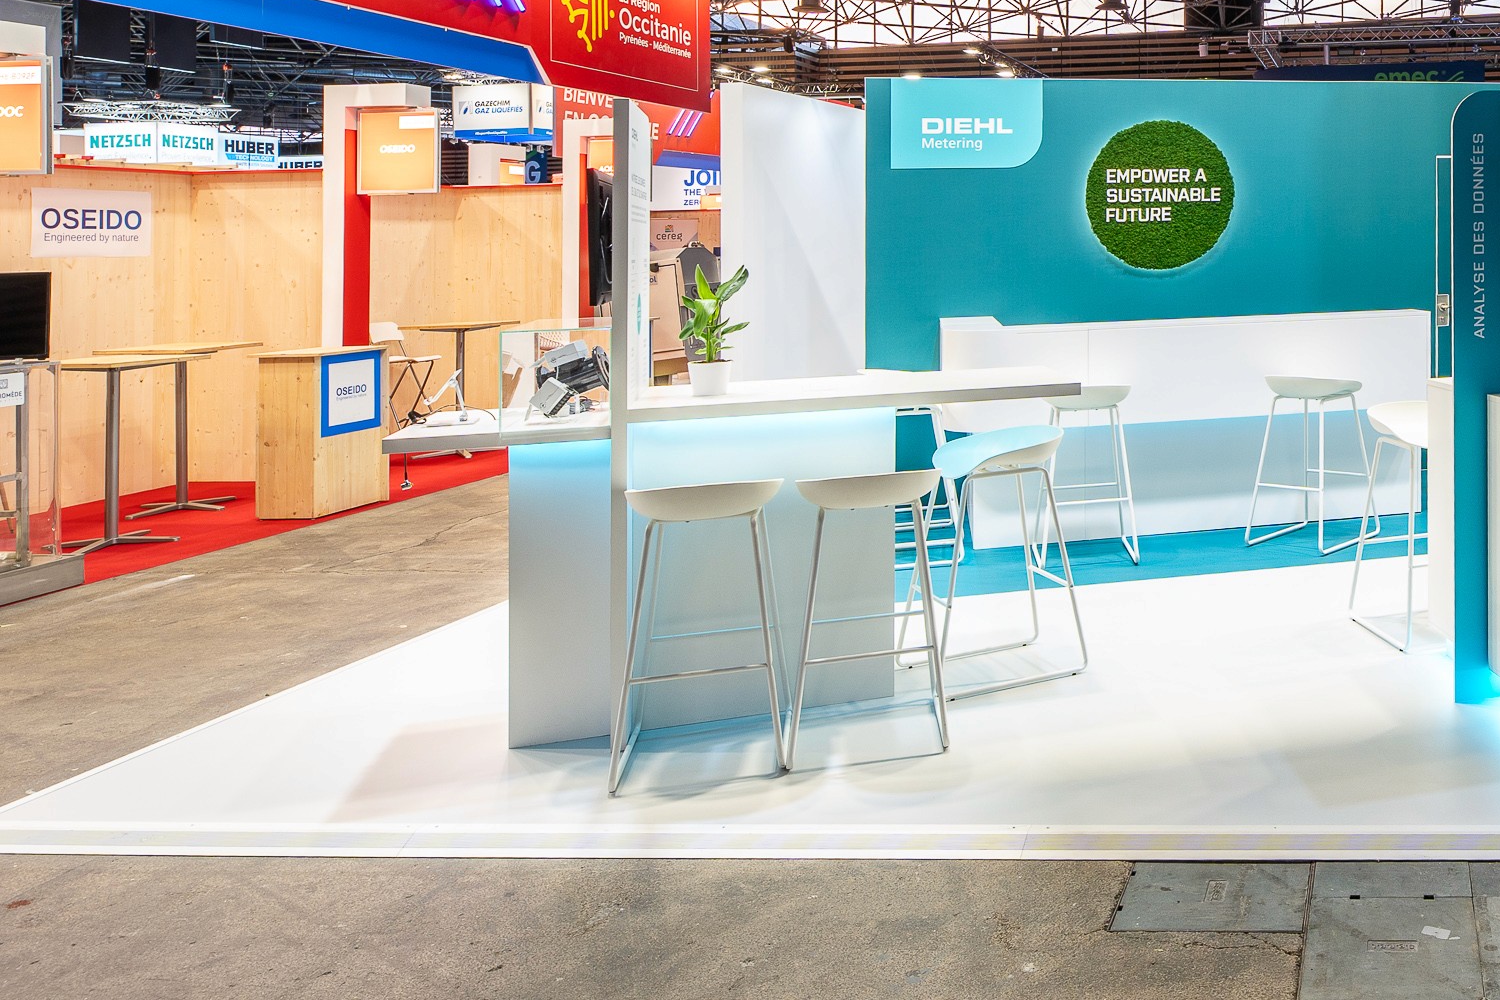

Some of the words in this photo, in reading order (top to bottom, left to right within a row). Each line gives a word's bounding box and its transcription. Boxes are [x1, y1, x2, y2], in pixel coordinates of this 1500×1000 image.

[619, 8, 692, 46] Occitanie
[620, 32, 649, 48] Pyrénées
[652, 40, 692, 58] Méditerranée
[564, 88, 613, 108] BIENVE
[922, 118, 1014, 134] DIEHL
[90, 134, 152, 148] NETZSCH
[162, 134, 214, 150] NETZSCH
[224, 140, 274, 154] HUBER
[922, 138, 983, 152] Metering
[235, 154, 274, 162] TECHNOLOGY
[684, 170, 721, 187] JOI
[1106, 168, 1190, 184] EMPOWER
[1194, 168, 1206, 182] A
[1470, 133, 1484, 214] DONNÉES
[1106, 187, 1221, 204] SUSTAINABLE
[41, 208, 142, 230] OSEIDO
[1106, 207, 1172, 223] FUTURE
[44, 232, 97, 244] Engineered
[99, 233, 109, 243] by
[112, 234, 139, 242] nature
[656, 232, 683, 241] cereg
[1473, 221, 1484, 254] DES
[1473, 262, 1485, 339] ANALYSE
[336, 384, 366, 396] OSEIDO
